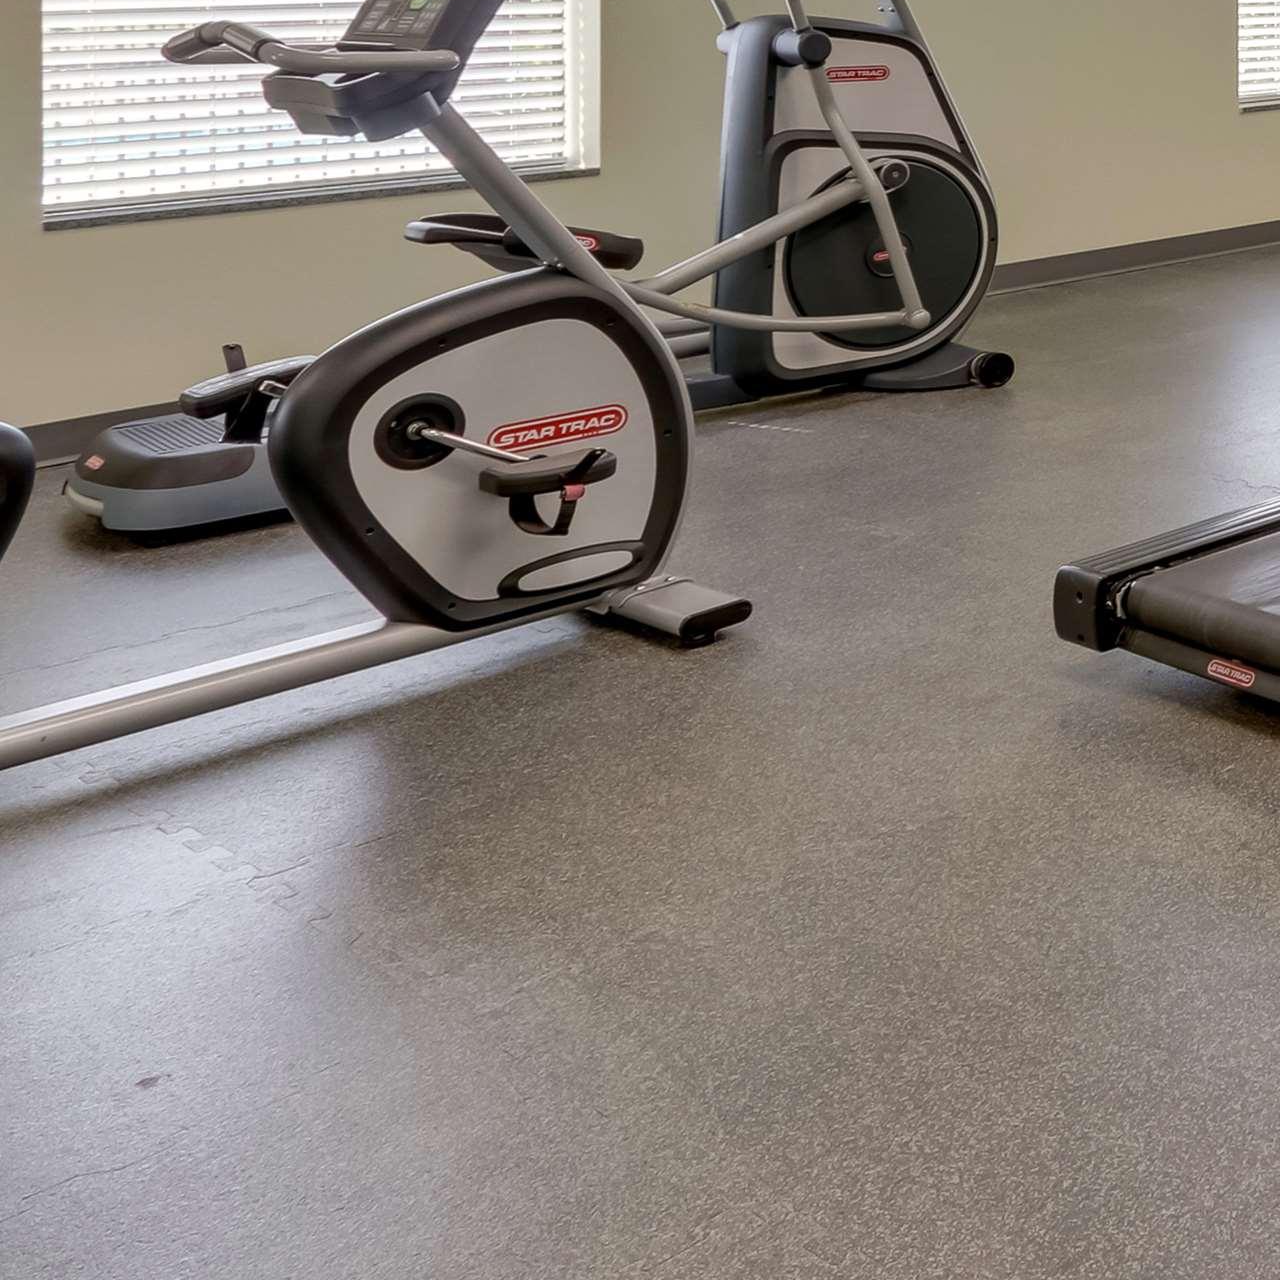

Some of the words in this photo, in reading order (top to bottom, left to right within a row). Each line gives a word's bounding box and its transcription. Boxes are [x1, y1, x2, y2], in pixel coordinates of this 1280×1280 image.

[829, 70, 856, 78] STAR
[857, 69, 885, 77] TRAC
[500, 426, 556, 446] STAR
[560, 414, 617, 435] TRAC
[1210, 663, 1231, 676] STAR
[1230, 670, 1252, 683] TRAC
